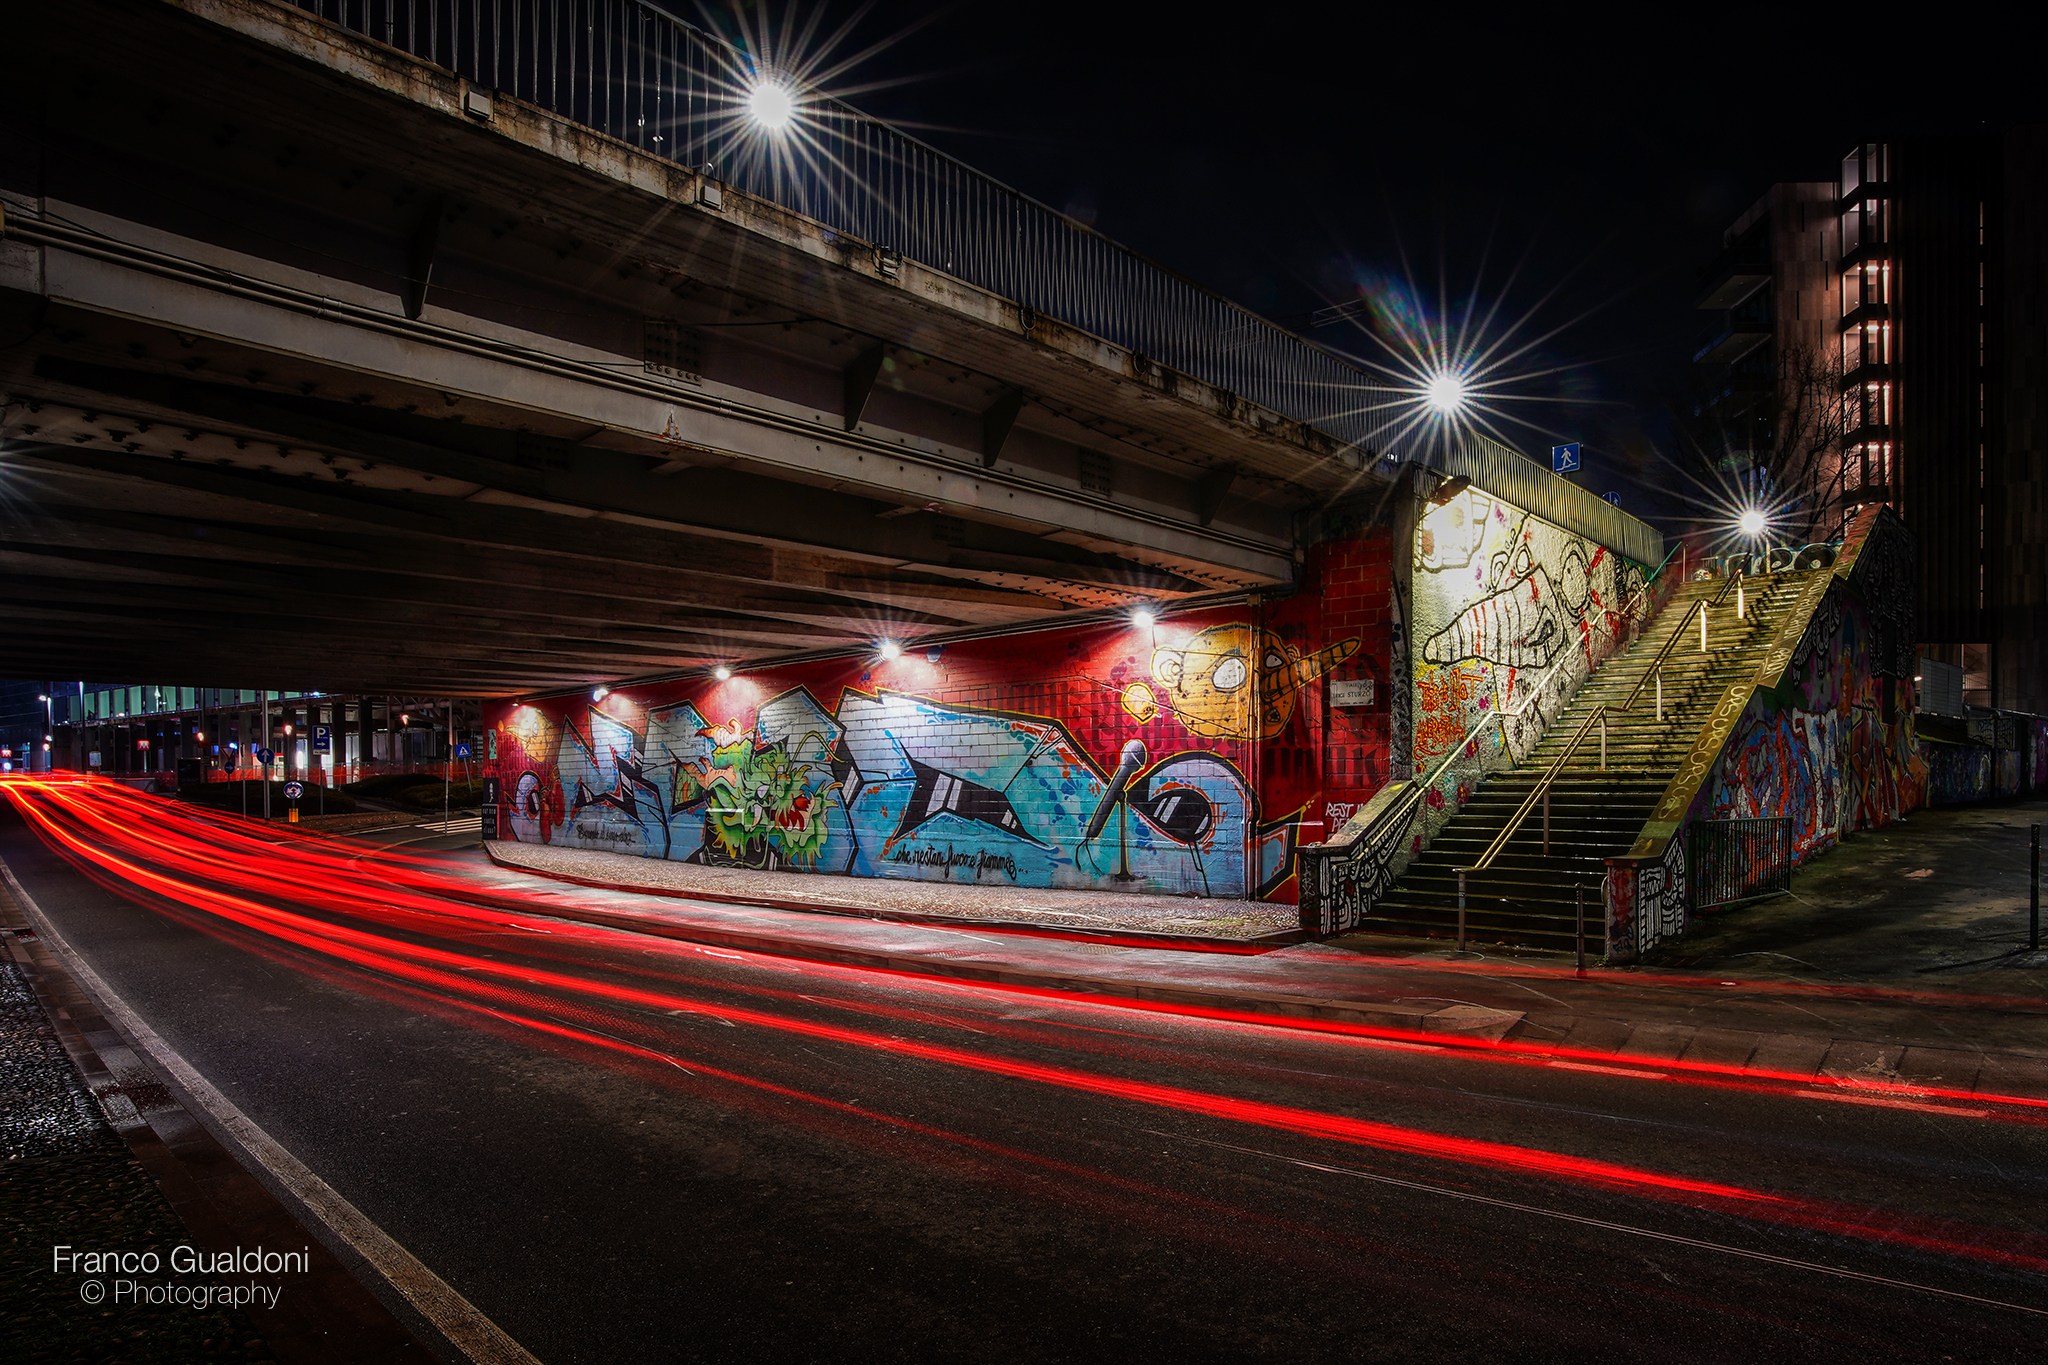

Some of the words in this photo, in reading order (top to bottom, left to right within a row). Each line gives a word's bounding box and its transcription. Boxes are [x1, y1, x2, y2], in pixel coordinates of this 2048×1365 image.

[1347, 690, 1371, 698] STURZO
[316, 727, 327, 739] P
[1325, 802, 1354, 817] REST
[1331, 816, 1350, 832] PE
[896, 843, 911, 864] che
[913, 845, 944, 867] restan
